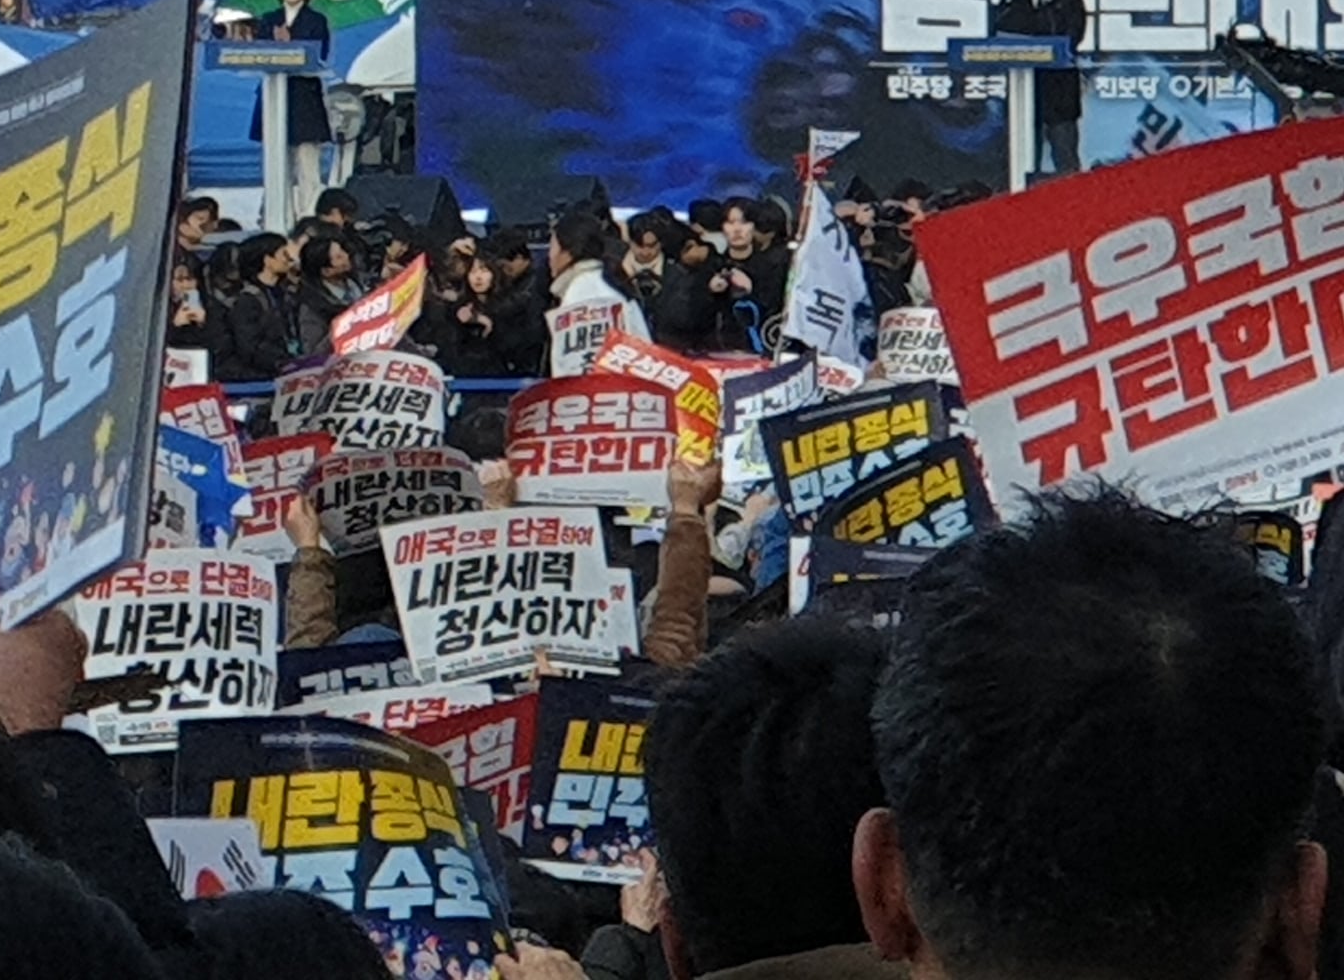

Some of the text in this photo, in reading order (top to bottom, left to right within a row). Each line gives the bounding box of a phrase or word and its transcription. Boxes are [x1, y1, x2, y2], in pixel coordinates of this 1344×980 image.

[887, 73, 953, 100] 민주당
[512, 390, 666, 438] 극우국힘
[852, 398, 931, 451] 종식
[511, 433, 670, 479] 규탄한다
[395, 523, 498, 566] 애국으로
[406, 548, 576, 613] 내란세력
[435, 595, 595, 657] 청산하자
[364, 846, 493, 922] 수호
